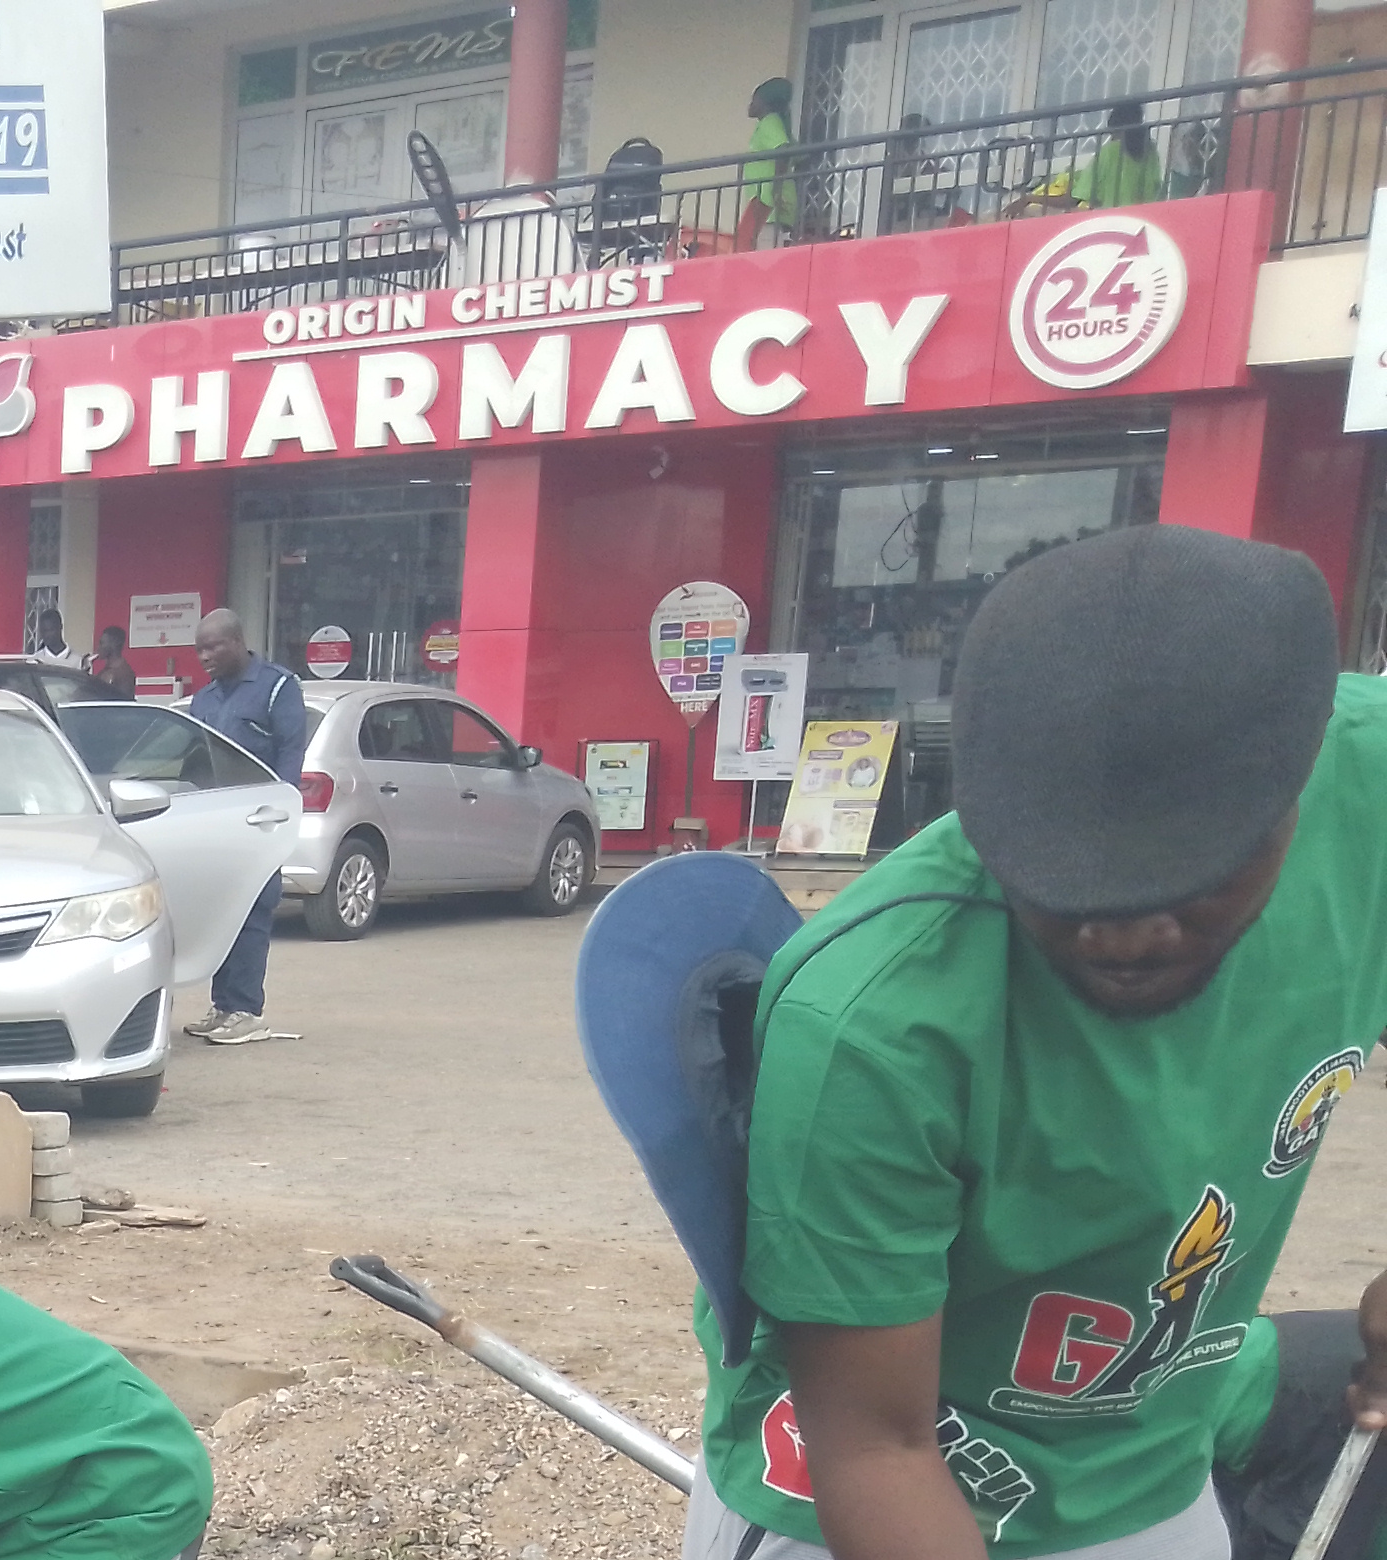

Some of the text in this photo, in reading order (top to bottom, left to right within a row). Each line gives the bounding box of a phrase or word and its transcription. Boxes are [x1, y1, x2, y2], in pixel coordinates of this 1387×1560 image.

[262, 264, 675, 346] ORIGIN CHEMIST
[1044, 260, 1142, 324] 24
[1046, 317, 1130, 342] HOURS
[61, 293, 950, 475] PHARMACY
[680, 700, 709, 713] HERE
[1288, 1124, 1321, 1154] GA
[1011, 1285, 1217, 1400] GA
[1193, 1336, 1241, 1357] FUTURE
